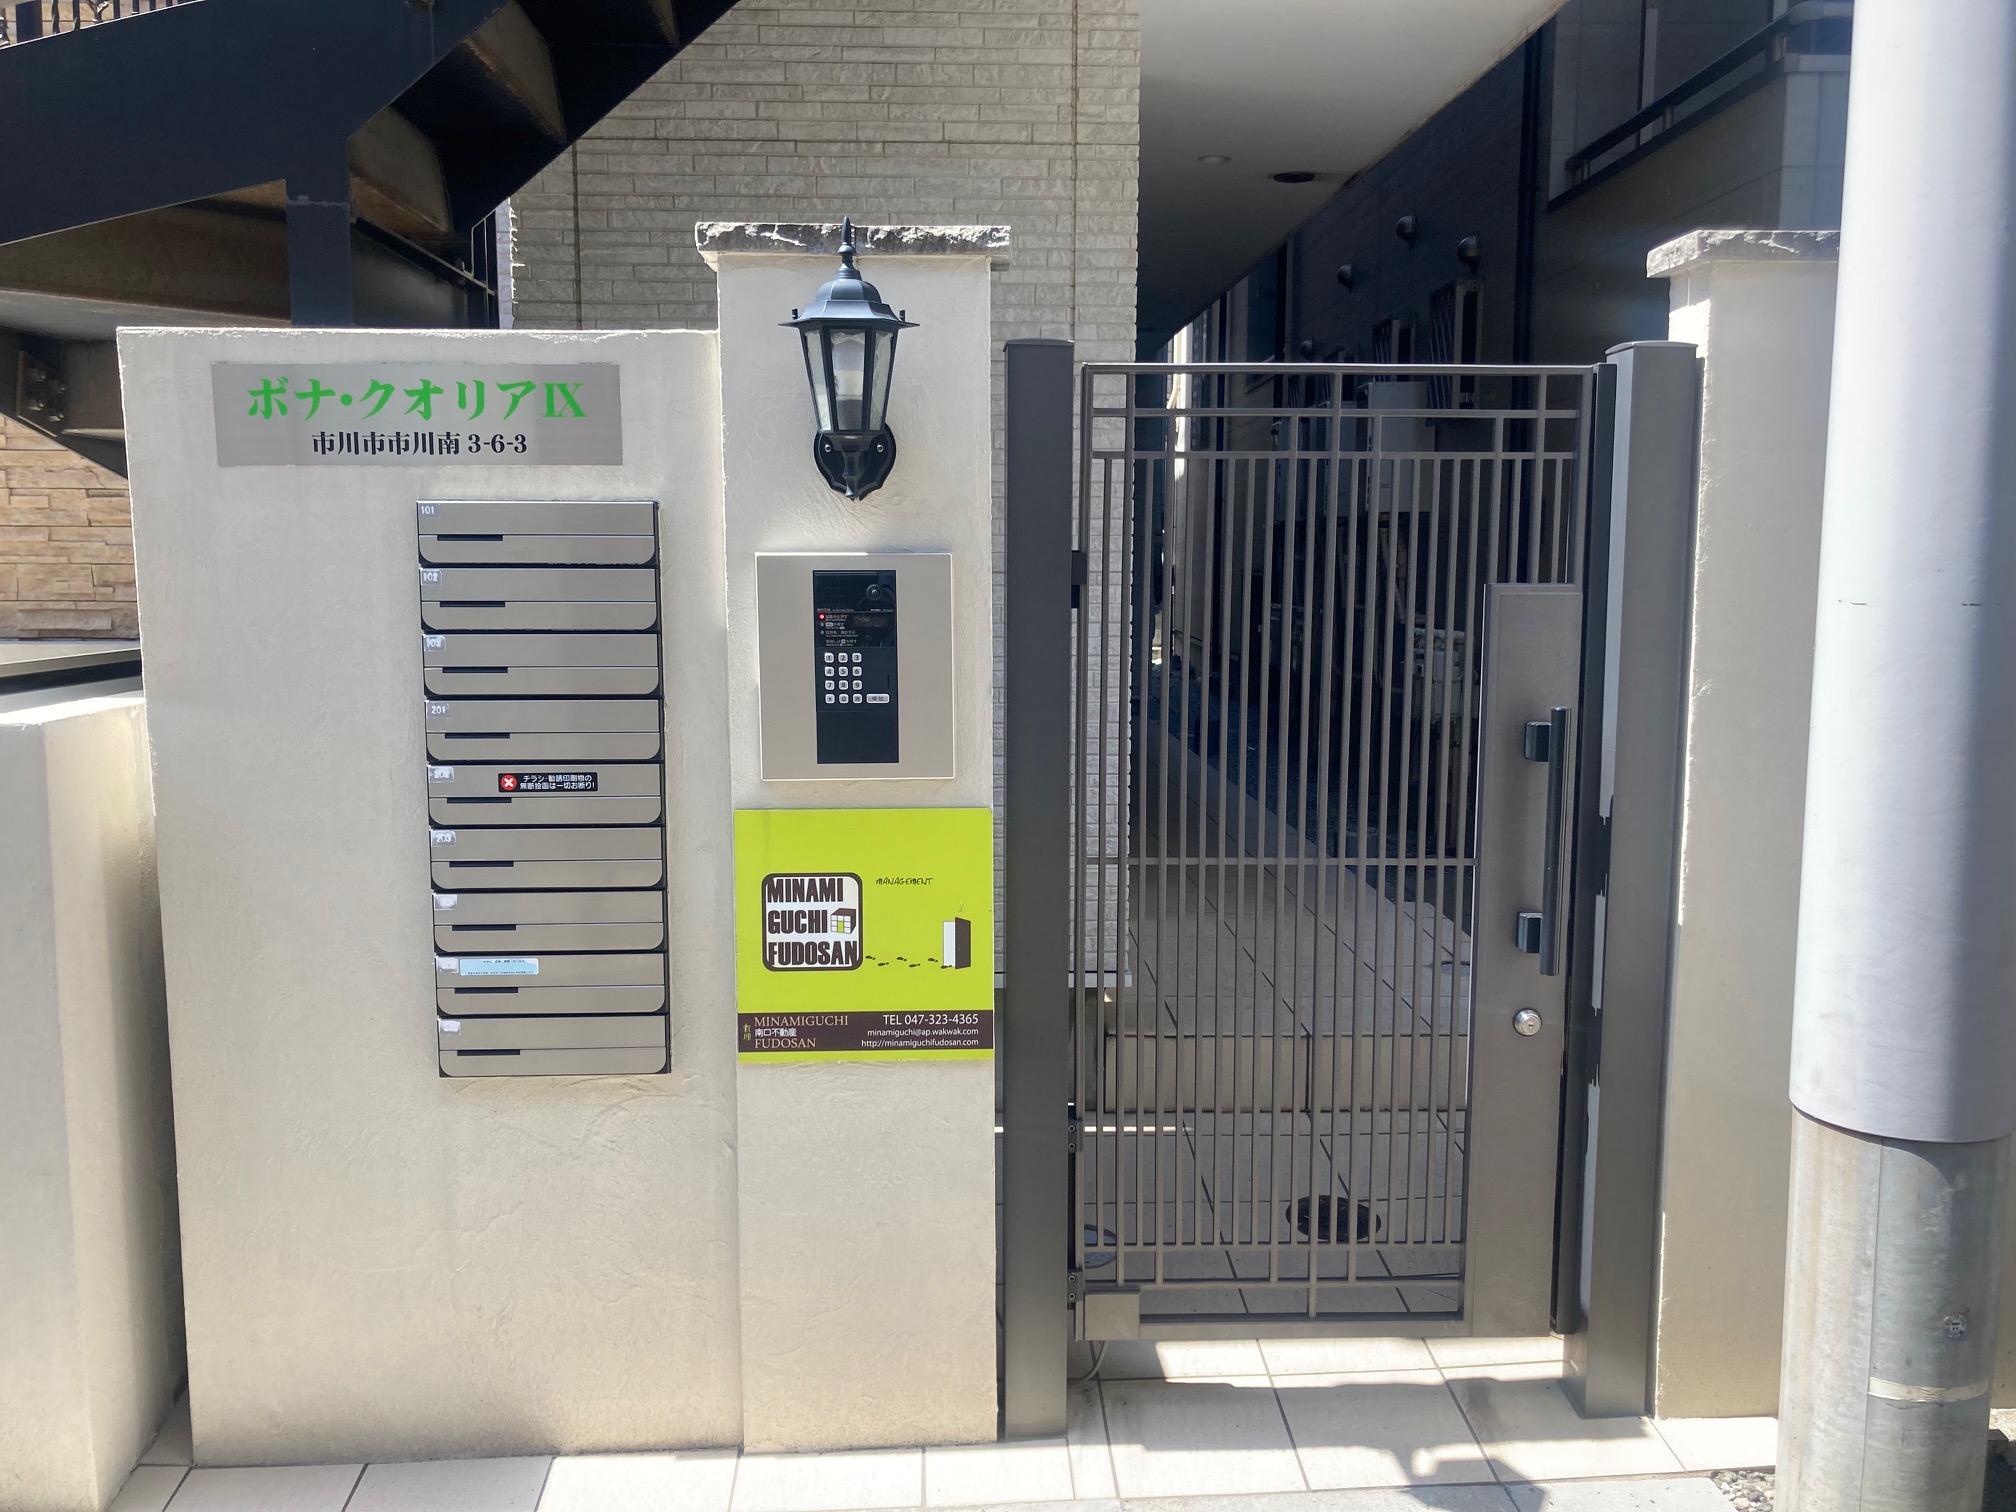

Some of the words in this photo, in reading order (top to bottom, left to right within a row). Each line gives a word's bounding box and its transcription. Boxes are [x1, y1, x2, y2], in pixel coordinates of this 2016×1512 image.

[311, 430, 461, 456] 市川市市川南
[467, 433, 528, 454] 3-6-3
[420, 505, 435, 516] 101
[423, 572, 439, 582] 102
[431, 705, 446, 715] 201
[767, 877, 844, 903] MINAMI
[767, 909, 828, 935] GUCHI
[768, 940, 858, 966] FUDOSAN
[753, 1015, 849, 1027] MINAMIGUCHI
[882, 1014, 902, 1026] TEL
[904, 1013, 979, 1025] 047-323-4365
[754, 1027, 797, 1038] 南口不動産
[867, 1027, 979, 1038] minamiguchi@ap.wakwak.com
[754, 1037, 817, 1049] FUDOSAN
[861, 1037, 979, 1048] http://minamiguchifudosan.com
